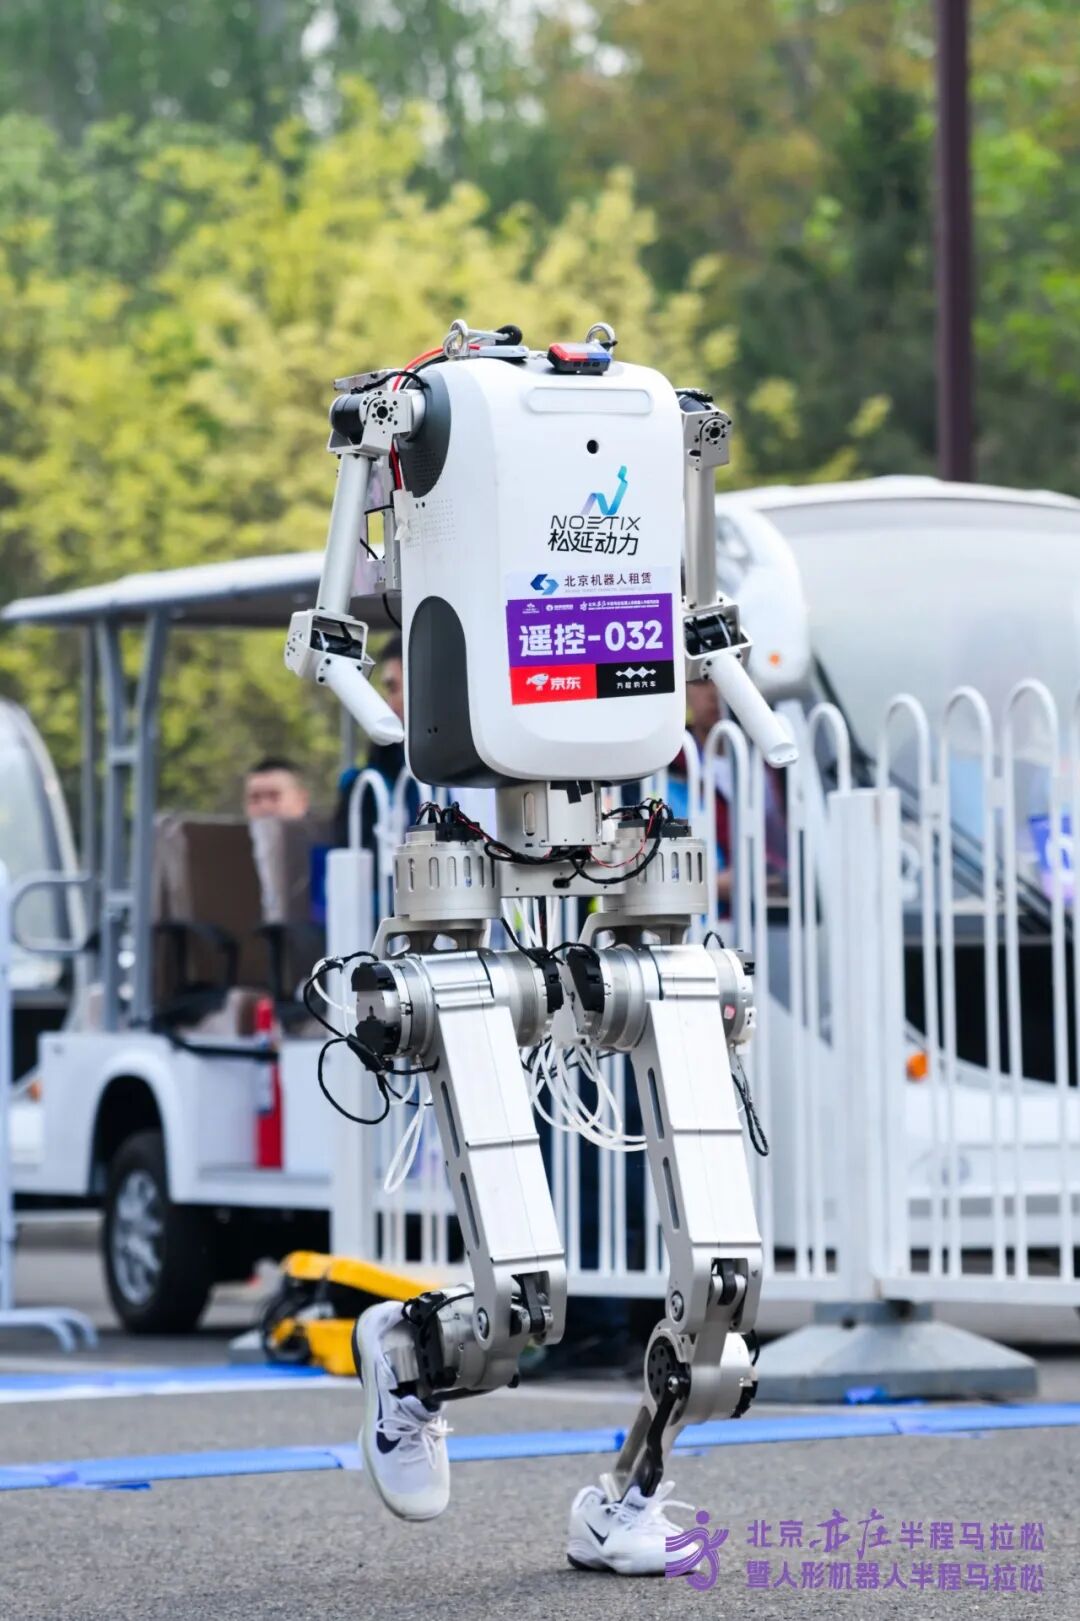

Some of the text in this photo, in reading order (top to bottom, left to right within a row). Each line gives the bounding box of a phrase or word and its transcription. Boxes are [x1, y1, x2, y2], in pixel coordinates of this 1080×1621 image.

[550, 515, 641, 531] NOETIX
[548, 529, 639, 556] 松延动力
[564, 572, 652, 587] 北京机器人租赁
[518, 620, 664, 658] 遥控-032
[550, 676, 582, 691] 京东
